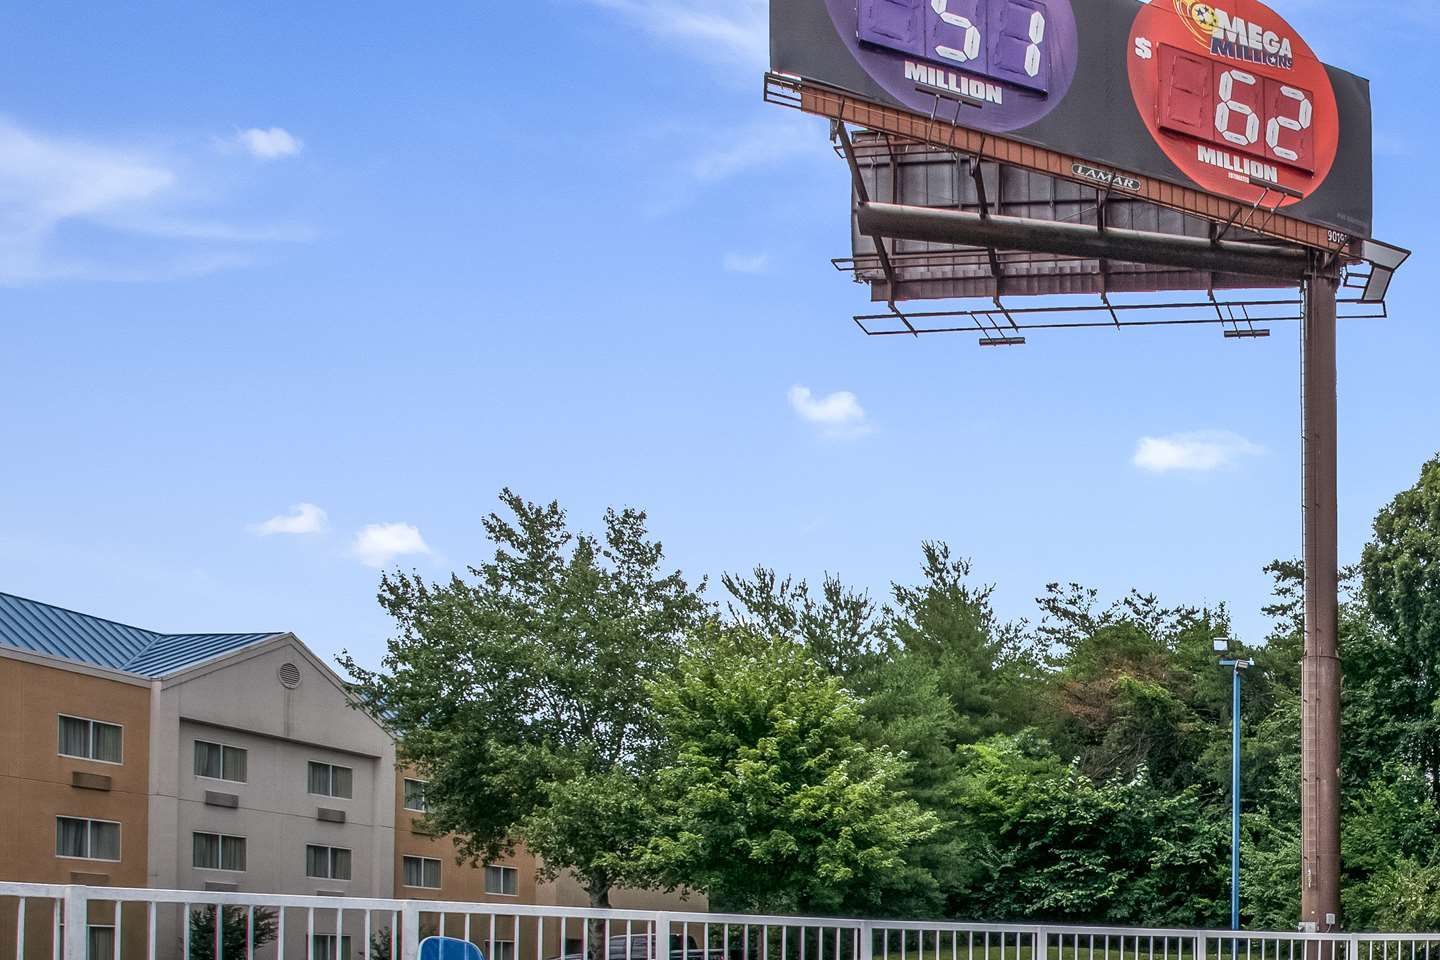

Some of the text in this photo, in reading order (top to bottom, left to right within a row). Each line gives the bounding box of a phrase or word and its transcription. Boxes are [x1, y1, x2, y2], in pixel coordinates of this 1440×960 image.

[1135, 37, 1152, 59] $
[1212, 8, 1293, 58] MEGA
[1210, 37, 1294, 69] MILLIONS
[904, 60, 1003, 105] MILLION
[1214, 69, 1312, 161] 62
[1077, 166, 1134, 188] LAMAR
[1197, 144, 1278, 183] MILLION
